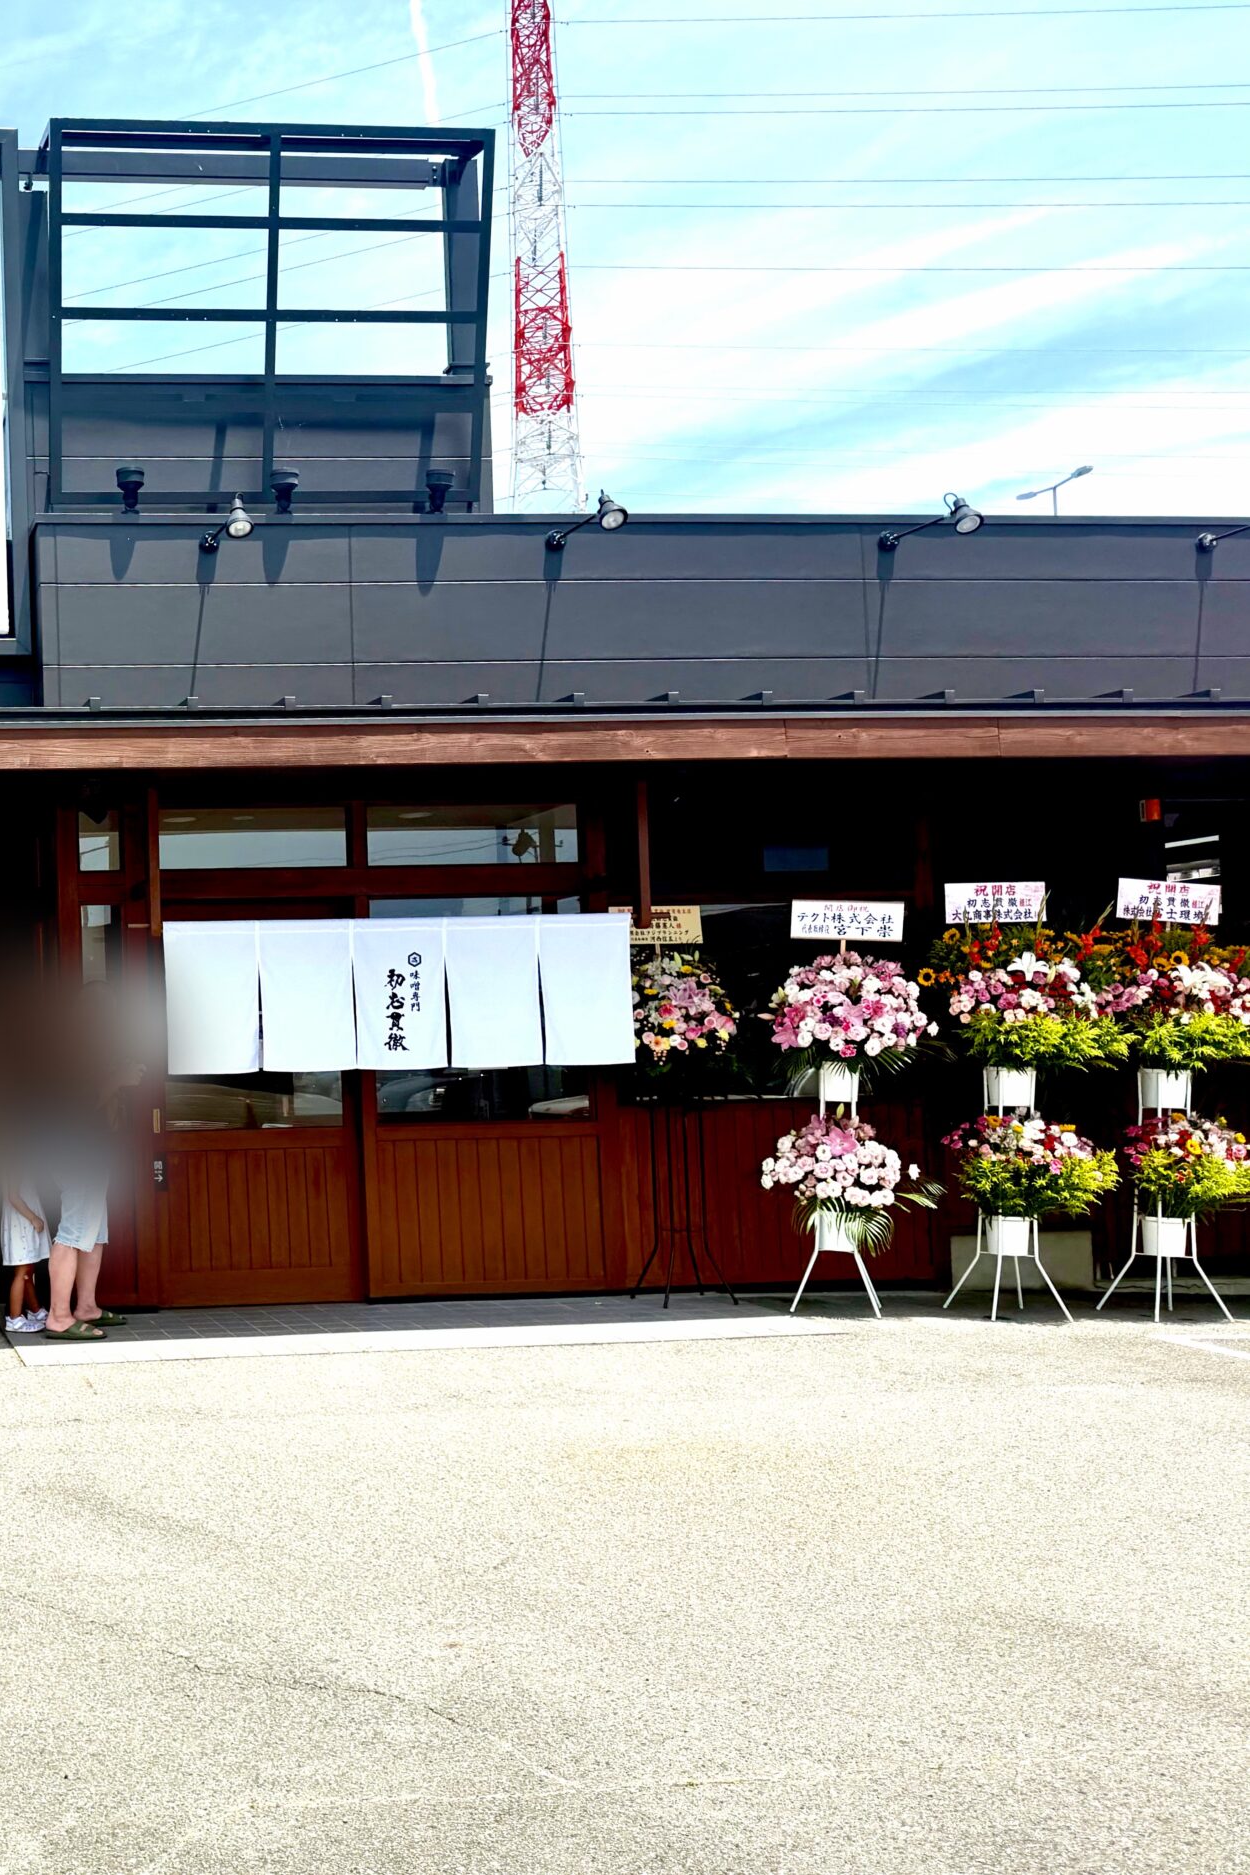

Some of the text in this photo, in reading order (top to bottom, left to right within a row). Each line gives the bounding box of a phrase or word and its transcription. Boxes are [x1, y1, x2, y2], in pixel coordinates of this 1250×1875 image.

[974, 885, 1016, 897] 祝開店
[1147, 883, 1190, 896] 祝開店
[797, 912, 894, 924] テクト株式会社
[384, 969, 410, 1051] 初志貫徹
